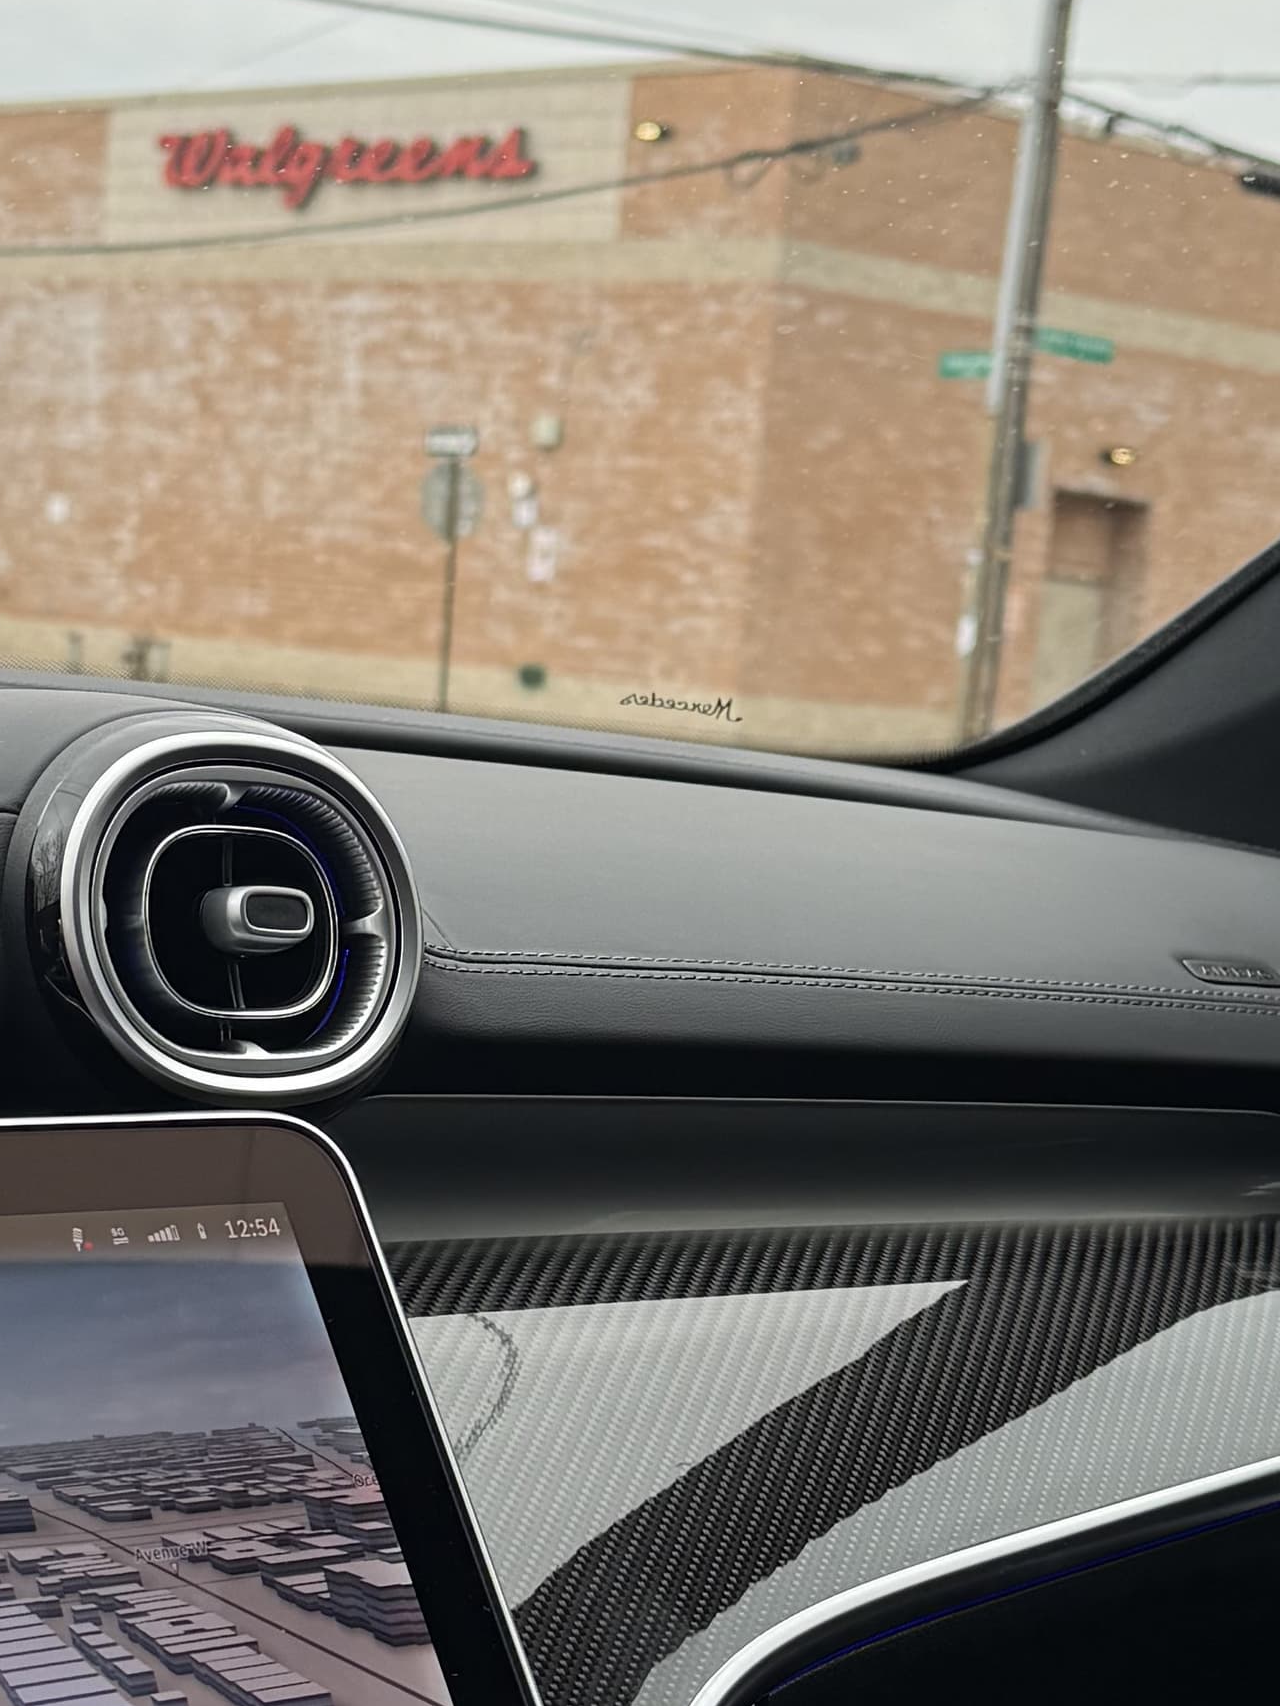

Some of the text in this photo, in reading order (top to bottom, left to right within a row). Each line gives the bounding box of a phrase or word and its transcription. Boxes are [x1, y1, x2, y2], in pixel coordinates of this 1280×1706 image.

[158, 123, 539, 211] Walgreens
[224, 1217, 281, 1240] 12:54
[135, 1541, 207, 1562] Avenue W
